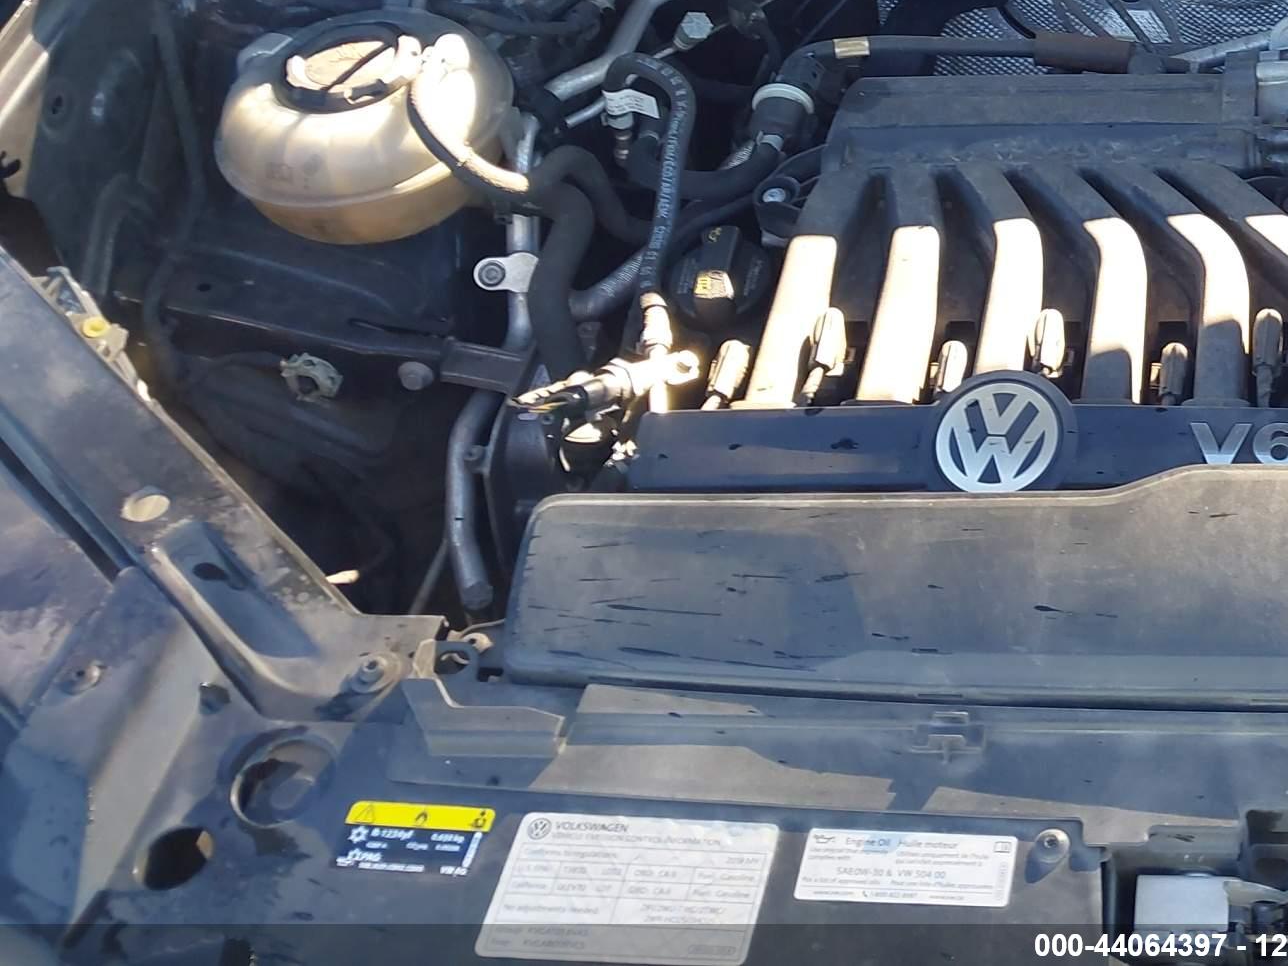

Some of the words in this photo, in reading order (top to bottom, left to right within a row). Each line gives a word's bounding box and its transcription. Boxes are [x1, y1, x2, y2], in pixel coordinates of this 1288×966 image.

[936, 382, 1058, 492] VW
[554, 820, 629, 832] VOLKSWAGEN
[845, 837, 876, 847] Engine
[877, 838, 891, 846] Oil
[897, 839, 922, 847] Huile
[934, 870, 946, 878] 00
